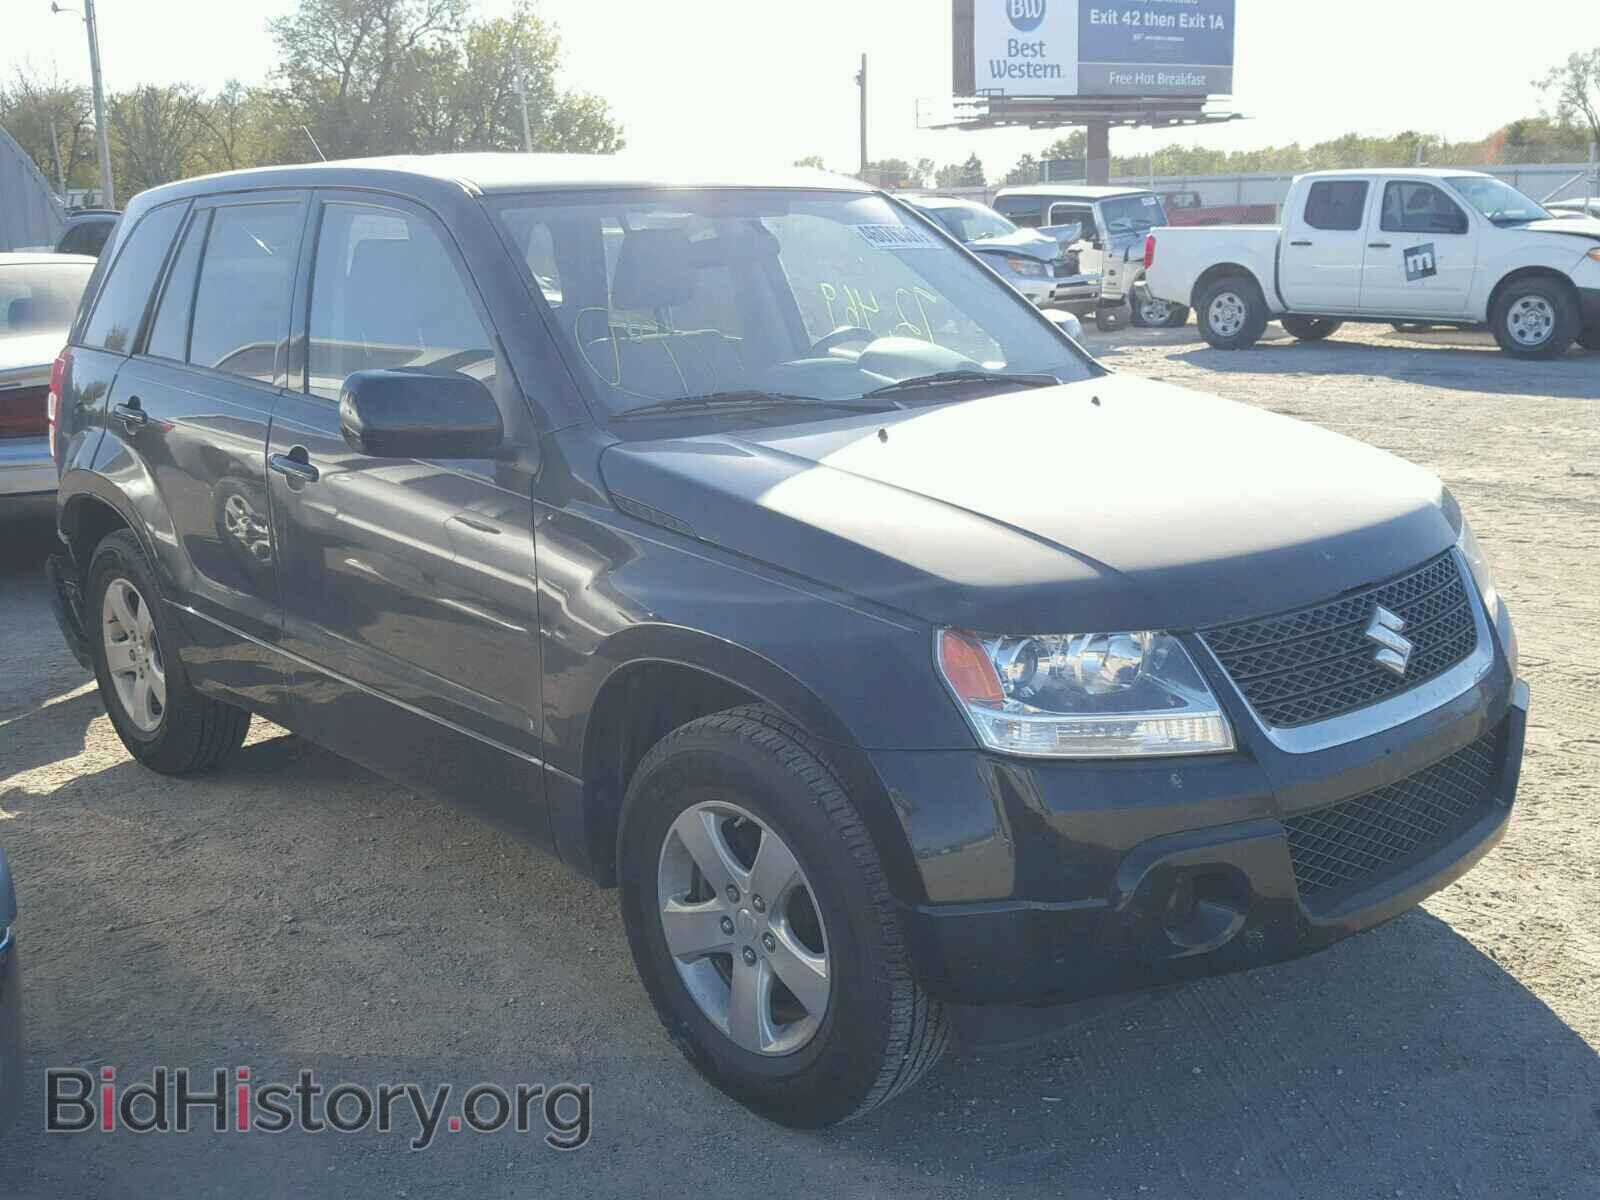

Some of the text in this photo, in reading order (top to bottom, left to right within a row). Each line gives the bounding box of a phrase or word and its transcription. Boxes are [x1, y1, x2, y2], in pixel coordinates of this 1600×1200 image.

[1012, 0, 1042, 18] BW
[1090, 9, 1225, 30] Exit 42 then Exit 1A
[1007, 38, 1046, 57] Best
[990, 59, 1061, 78] Western
[1109, 71, 1206, 86] Free Hot Breakfast
